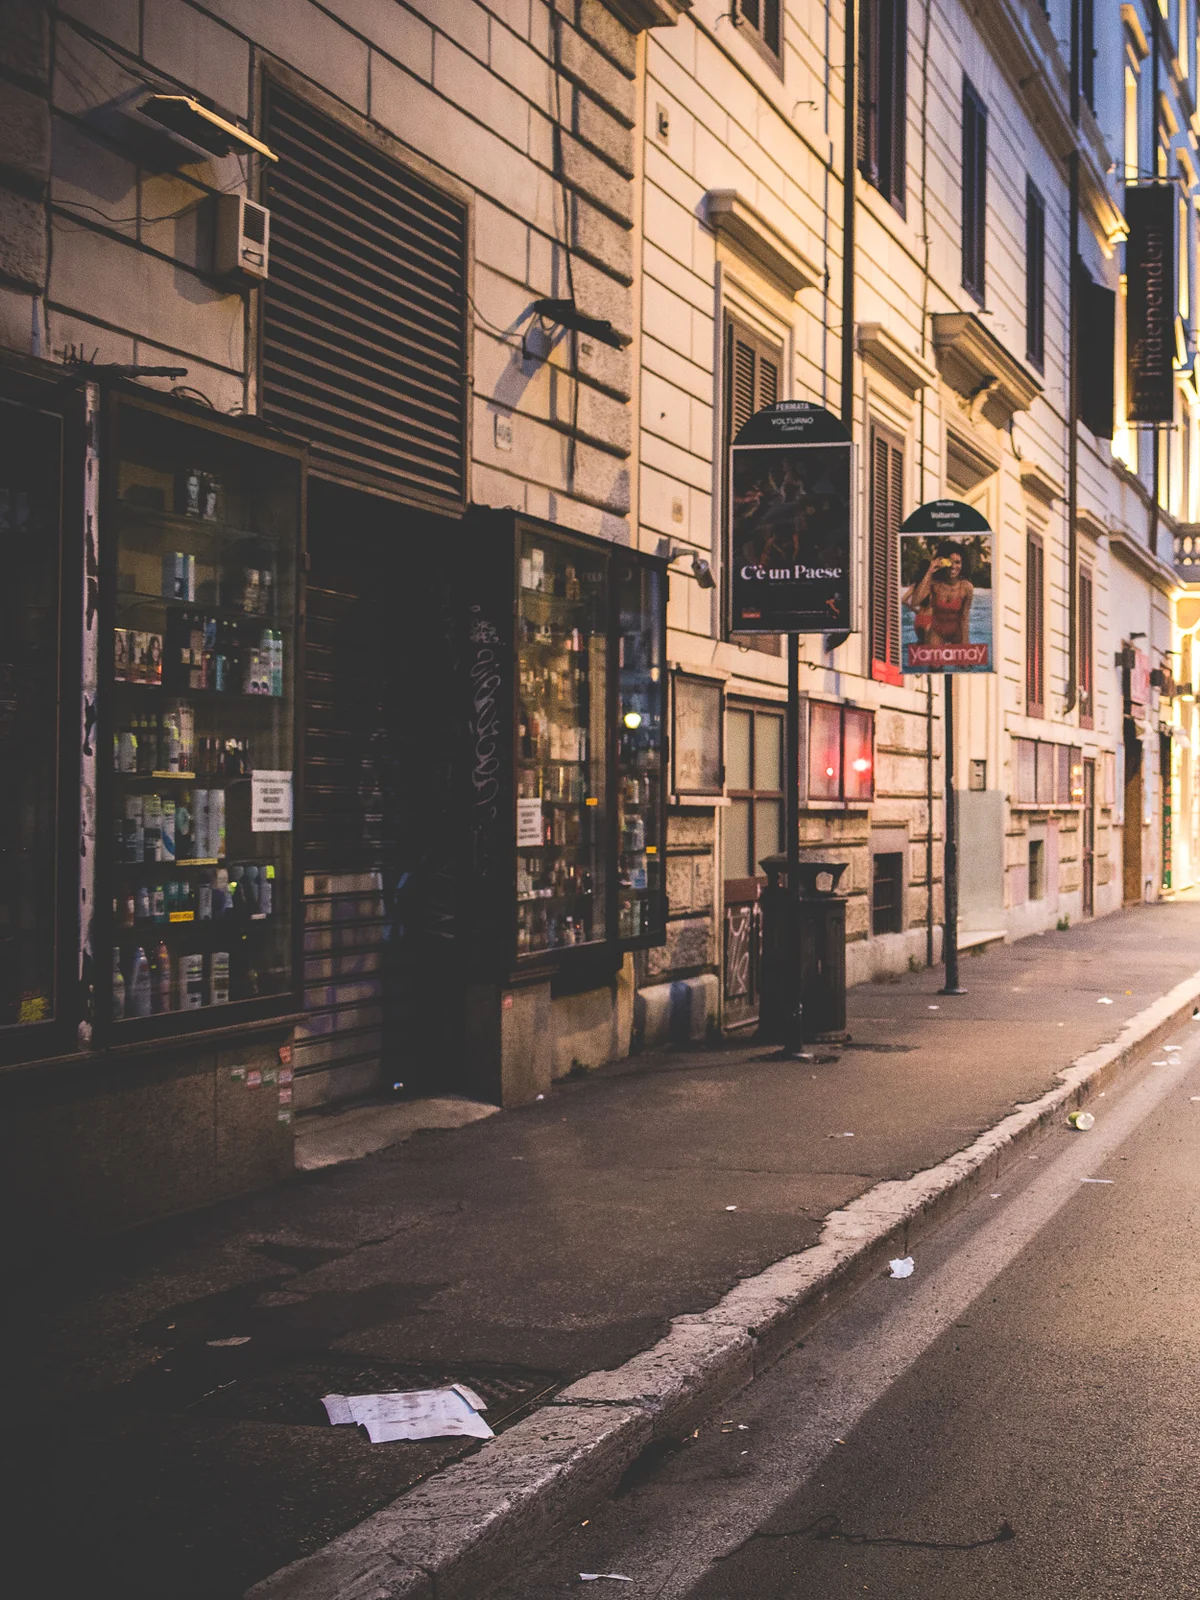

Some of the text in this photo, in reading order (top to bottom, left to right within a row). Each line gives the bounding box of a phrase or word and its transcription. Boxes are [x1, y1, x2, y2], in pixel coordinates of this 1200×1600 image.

[1139, 225, 1168, 377] Independent
[771, 417, 814, 425] VOLTURNO
[769, 568, 791, 579] un
[794, 564, 842, 579] Paese
[910, 645, 986, 664] yamamay
